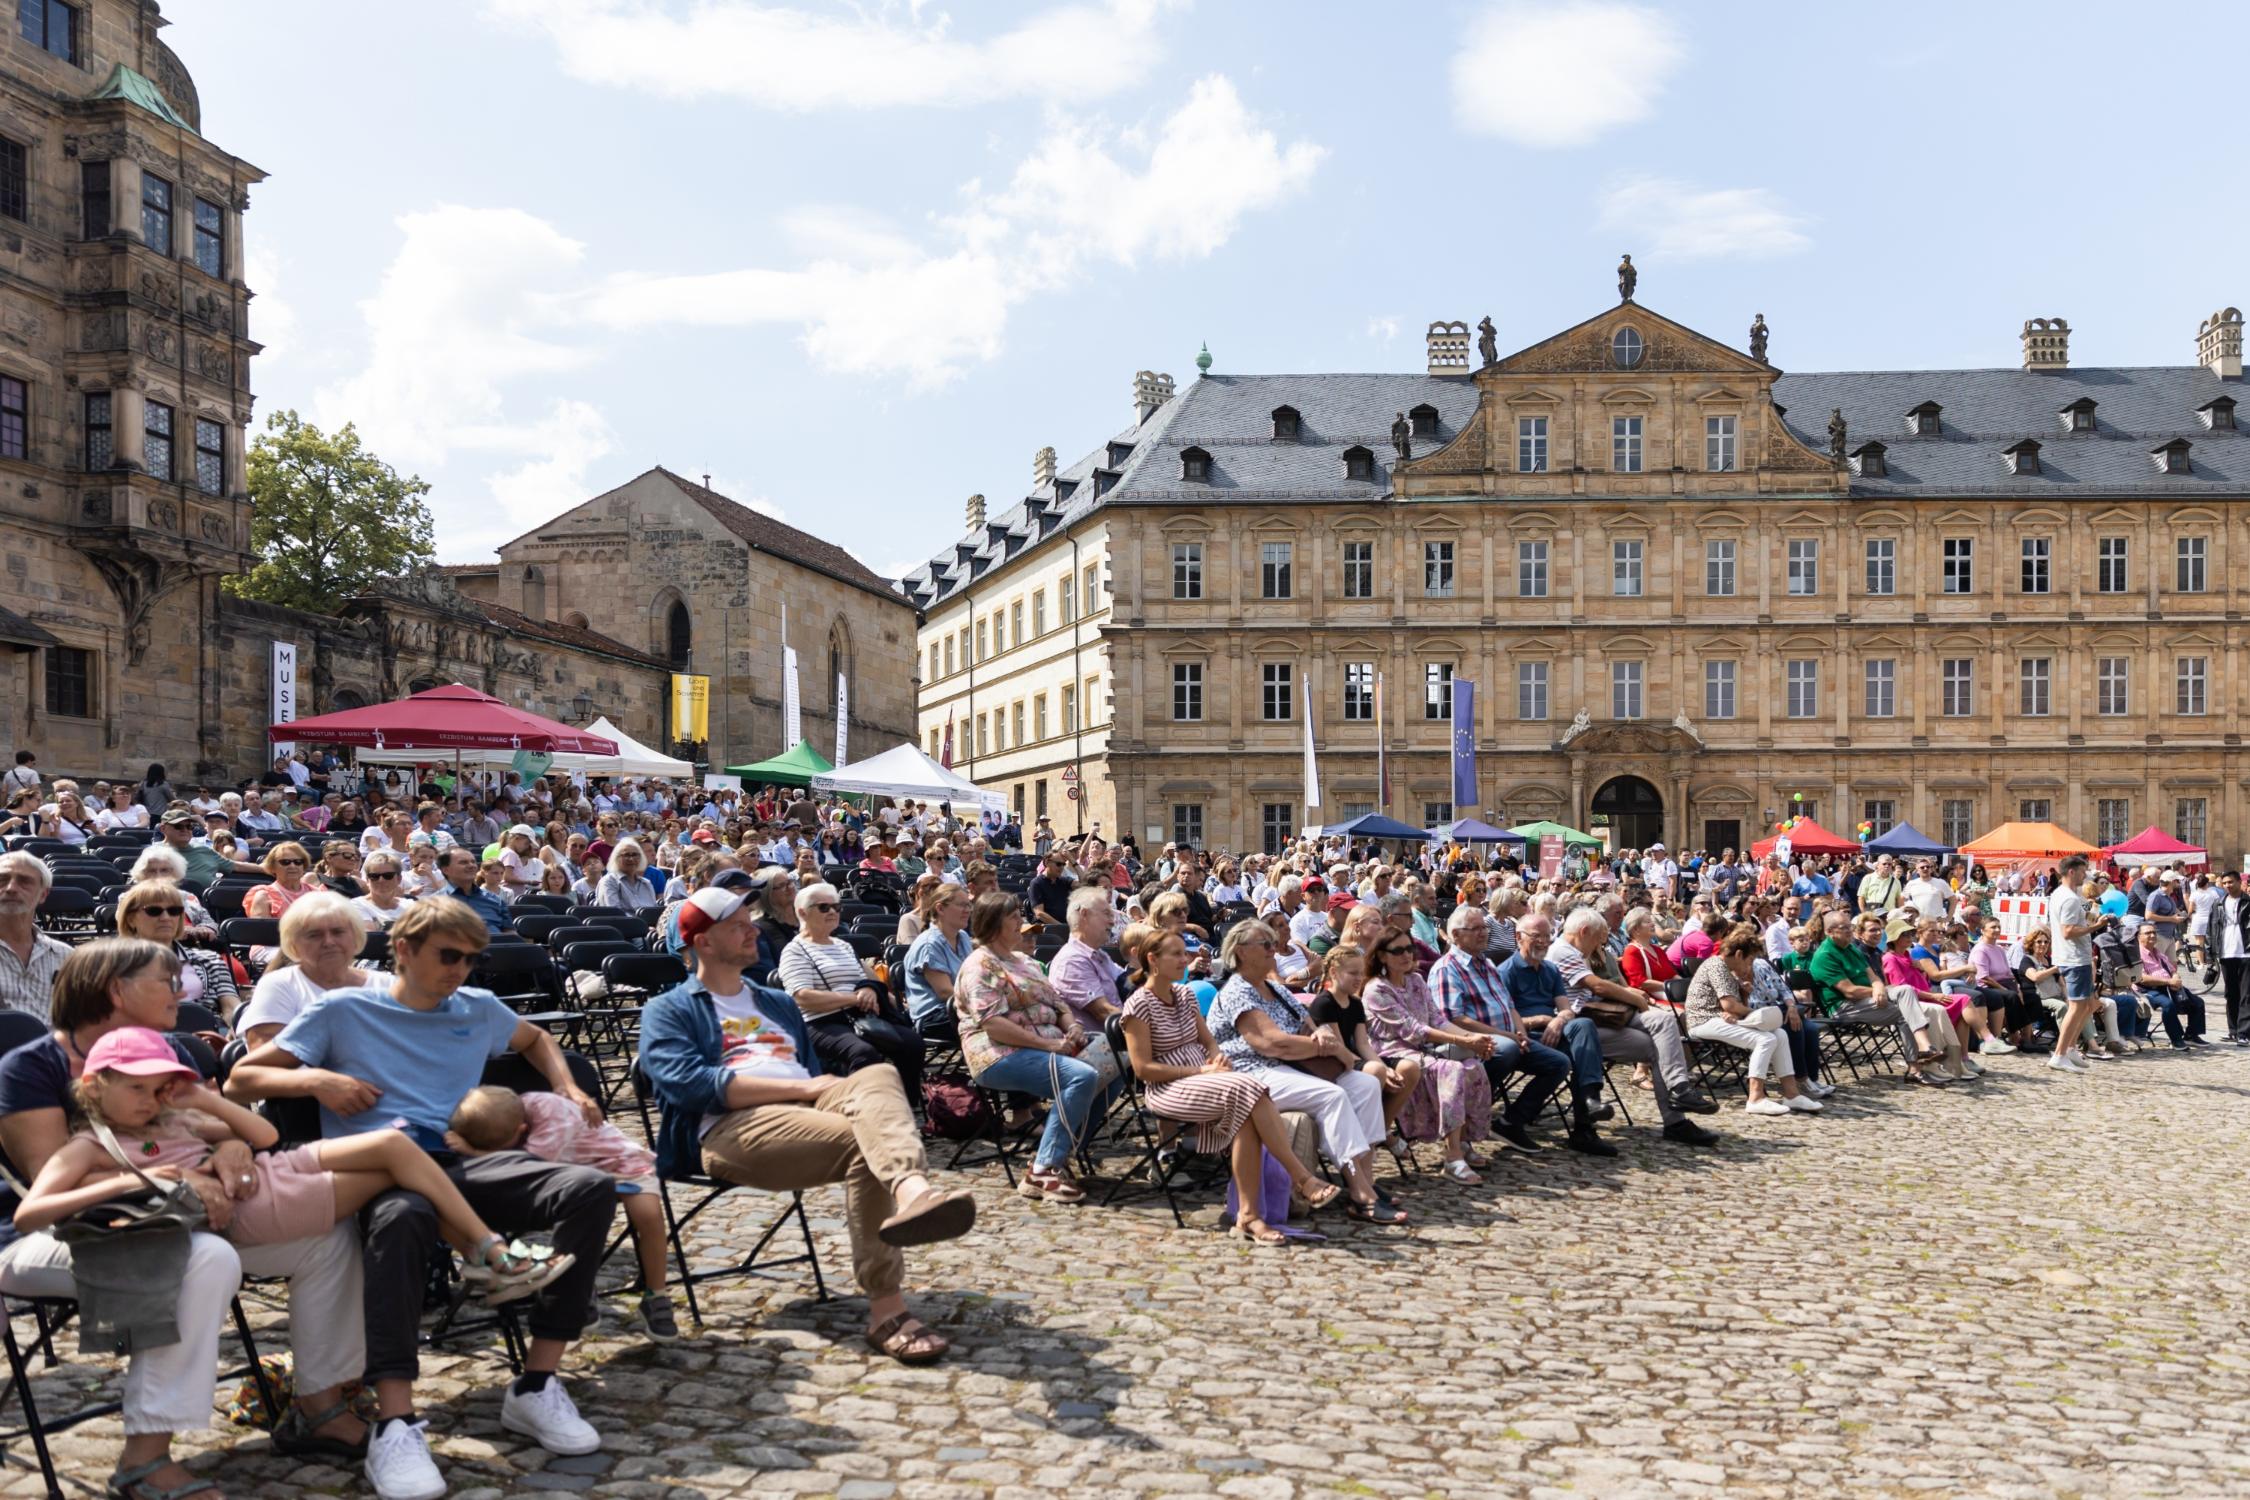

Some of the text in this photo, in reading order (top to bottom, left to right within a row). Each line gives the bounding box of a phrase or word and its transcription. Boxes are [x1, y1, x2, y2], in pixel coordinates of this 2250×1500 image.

[279, 650, 290, 758] MUSEM
[338, 730, 370, 738] BAMBERG
[439, 733, 475, 741] ERZBISTUM
